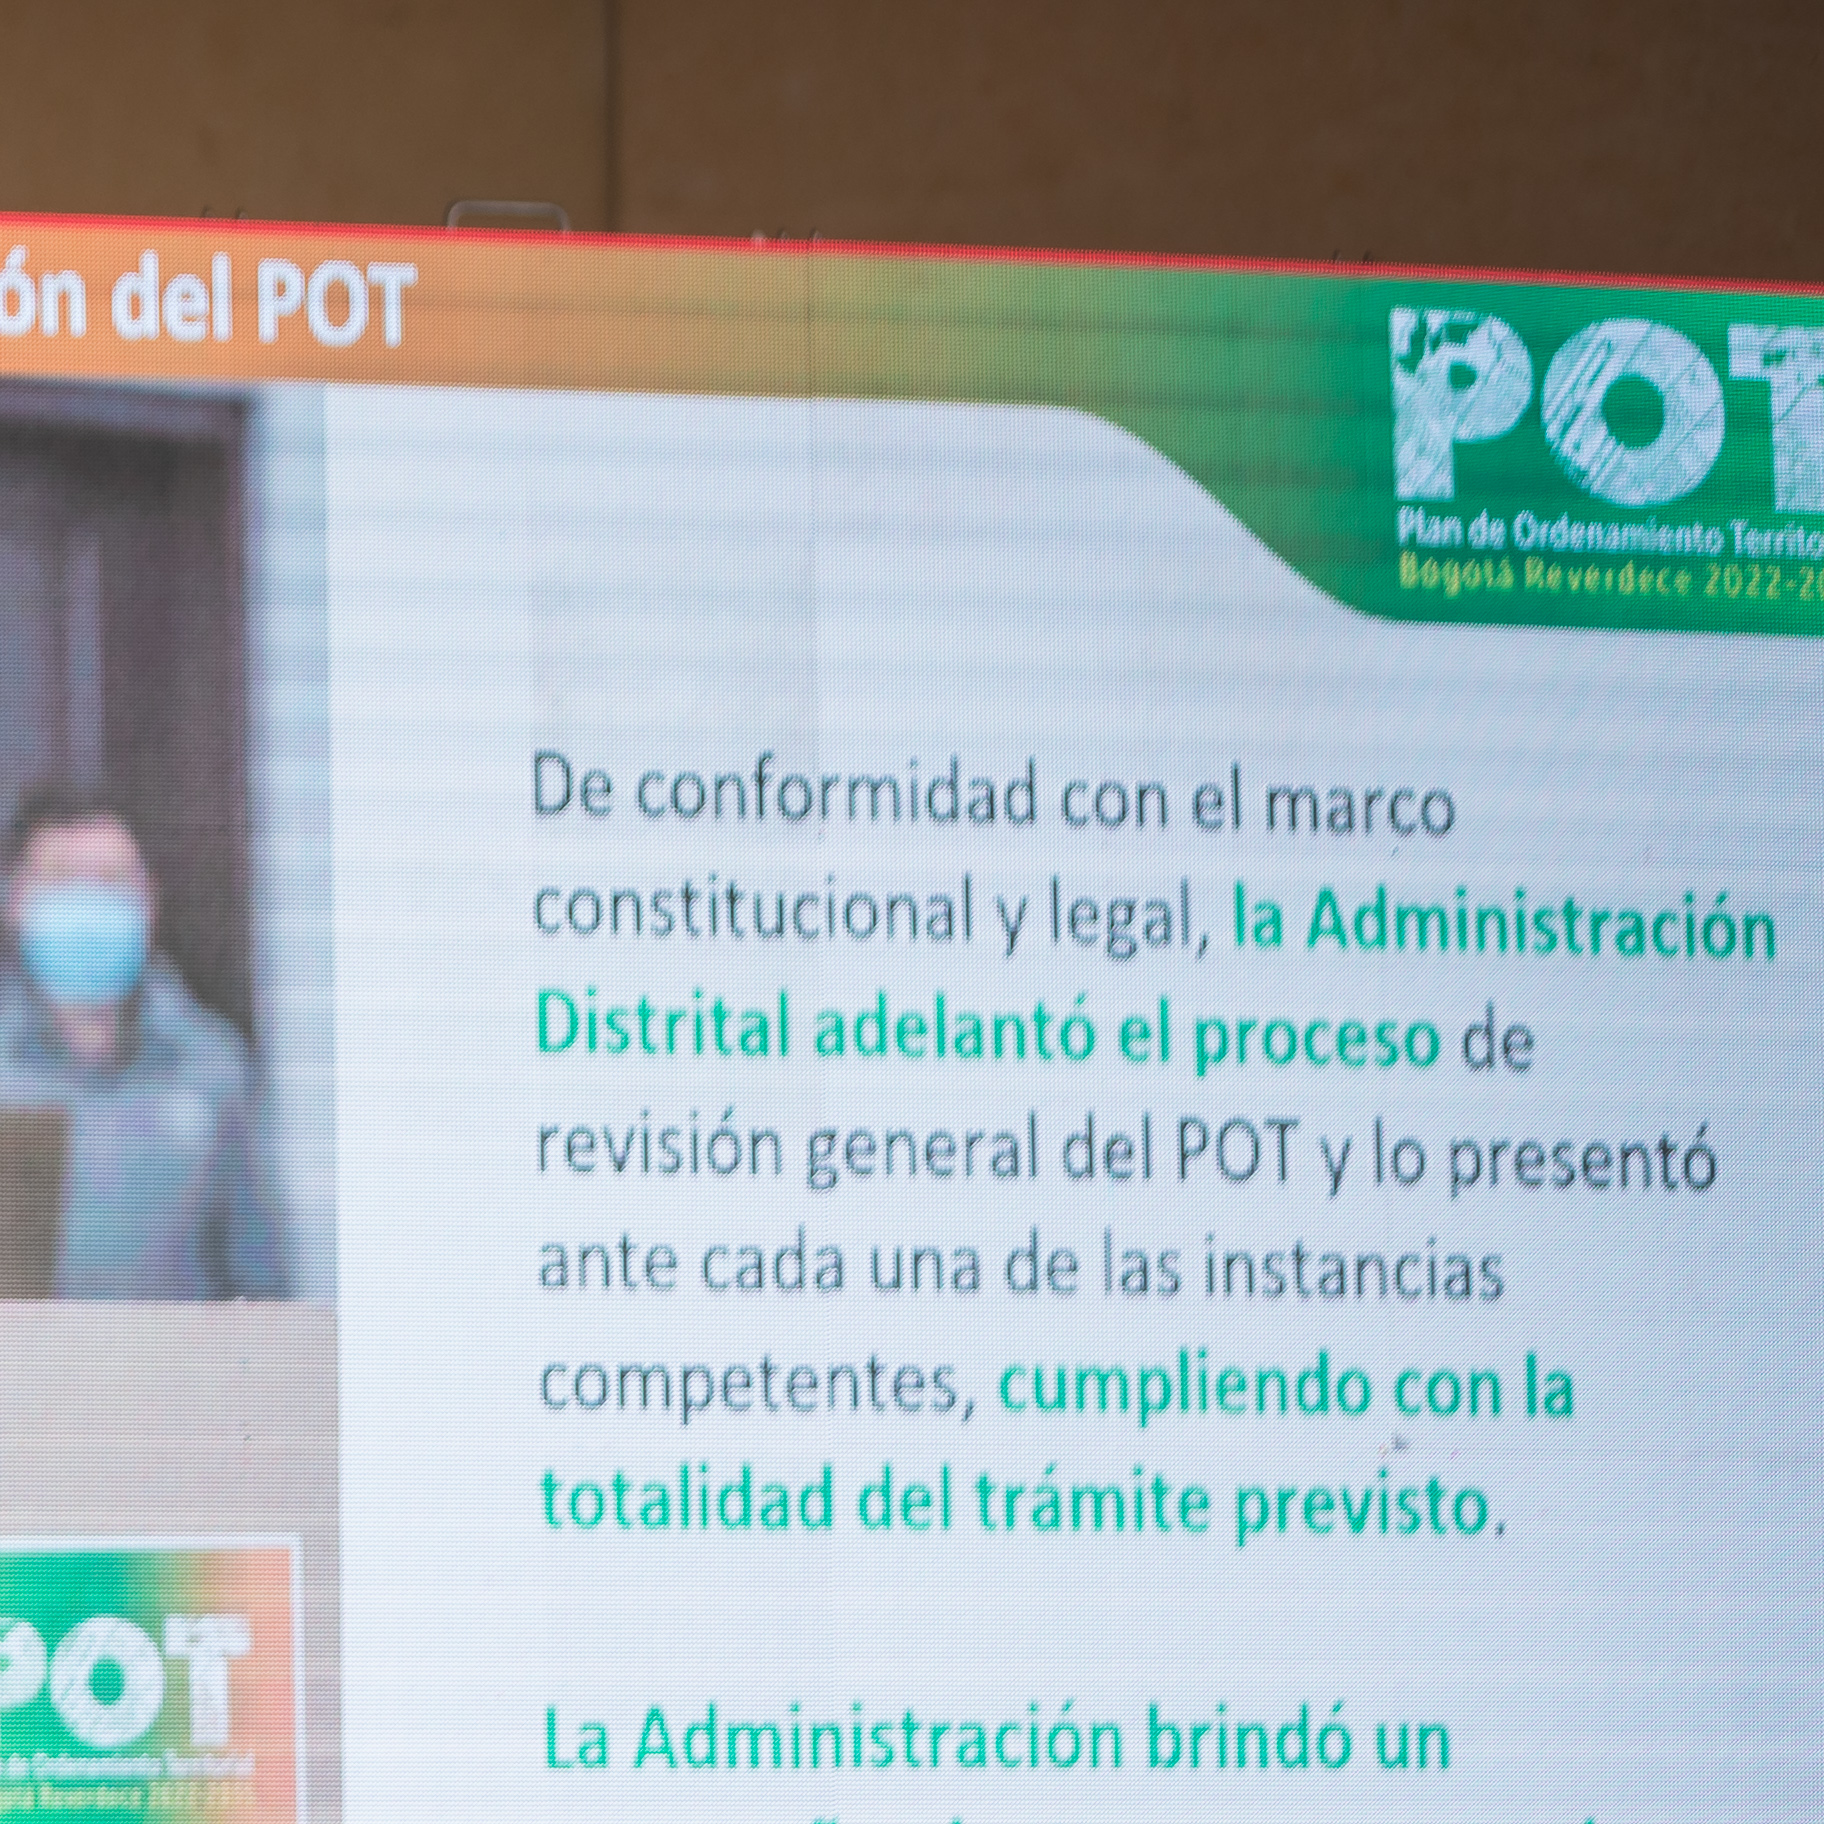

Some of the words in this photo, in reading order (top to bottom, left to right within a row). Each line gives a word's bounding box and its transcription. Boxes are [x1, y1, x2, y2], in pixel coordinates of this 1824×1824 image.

[109, 249, 234, 343] del
[256, 258, 419, 348] POT
[1389, 305, 1824, 513] POT
[1397, 505, 1465, 548] Plan
[1468, 508, 1507, 549] de
[1512, 509, 1725, 557] Ordenamiento
[1524, 554, 1692, 596] Reverdece
[532, 748, 614, 818] De
[635, 749, 1038, 827] conformidad
[1060, 780, 1169, 829] con
[1191, 762, 1243, 832] el
[1266, 786, 1456, 837] marco
[533, 873, 973, 941] constitucional
[996, 897, 1028, 957] y
[1050, 875, 1209, 962] legal,
[1232, 879, 1285, 950] la
[1305, 882, 1778, 963] Administración
[535, 984, 792, 1059] Distrital
[812, 989, 1098, 1064] adelantó
[1117, 994, 1173, 1065] el
[1192, 1016, 1443, 1080] proceso
[1462, 1002, 1535, 1073] de
[537, 1106, 782, 1176] revisión
[806, 1111, 1039, 1191] general
[1062, 1112, 1153, 1182] del
[1177, 1116, 1299, 1184] POT
[1320, 1138, 1352, 1197] y
[1374, 1118, 1427, 1186] lo
[1450, 1122, 1718, 1198] presentó
[538, 1233, 679, 1291] ante
[701, 1227, 845, 1292] cada
[870, 1247, 981, 1293] una
[1004, 1228, 1080, 1294] de
[1104, 1231, 1182, 1296] las
[1206, 1235, 1504, 1301] instancias
[540, 1355, 975, 1426] competentes,
[997, 1346, 1374, 1430] cumpliendo
[1393, 1367, 1503, 1418] con
[1523, 1349, 1576, 1420] la
[538, 1460, 836, 1533] totalidad
[855, 1461, 954, 1533] del
[973, 1462, 1213, 1535] trámite
[1234, 1465, 1505, 1549] previsto.
[543, 1703, 611, 1771] La
[631, 1698, 1124, 1771] Administración
[1145, 1699, 1354, 1772] brindó
[1374, 1721, 1452, 1772] un
